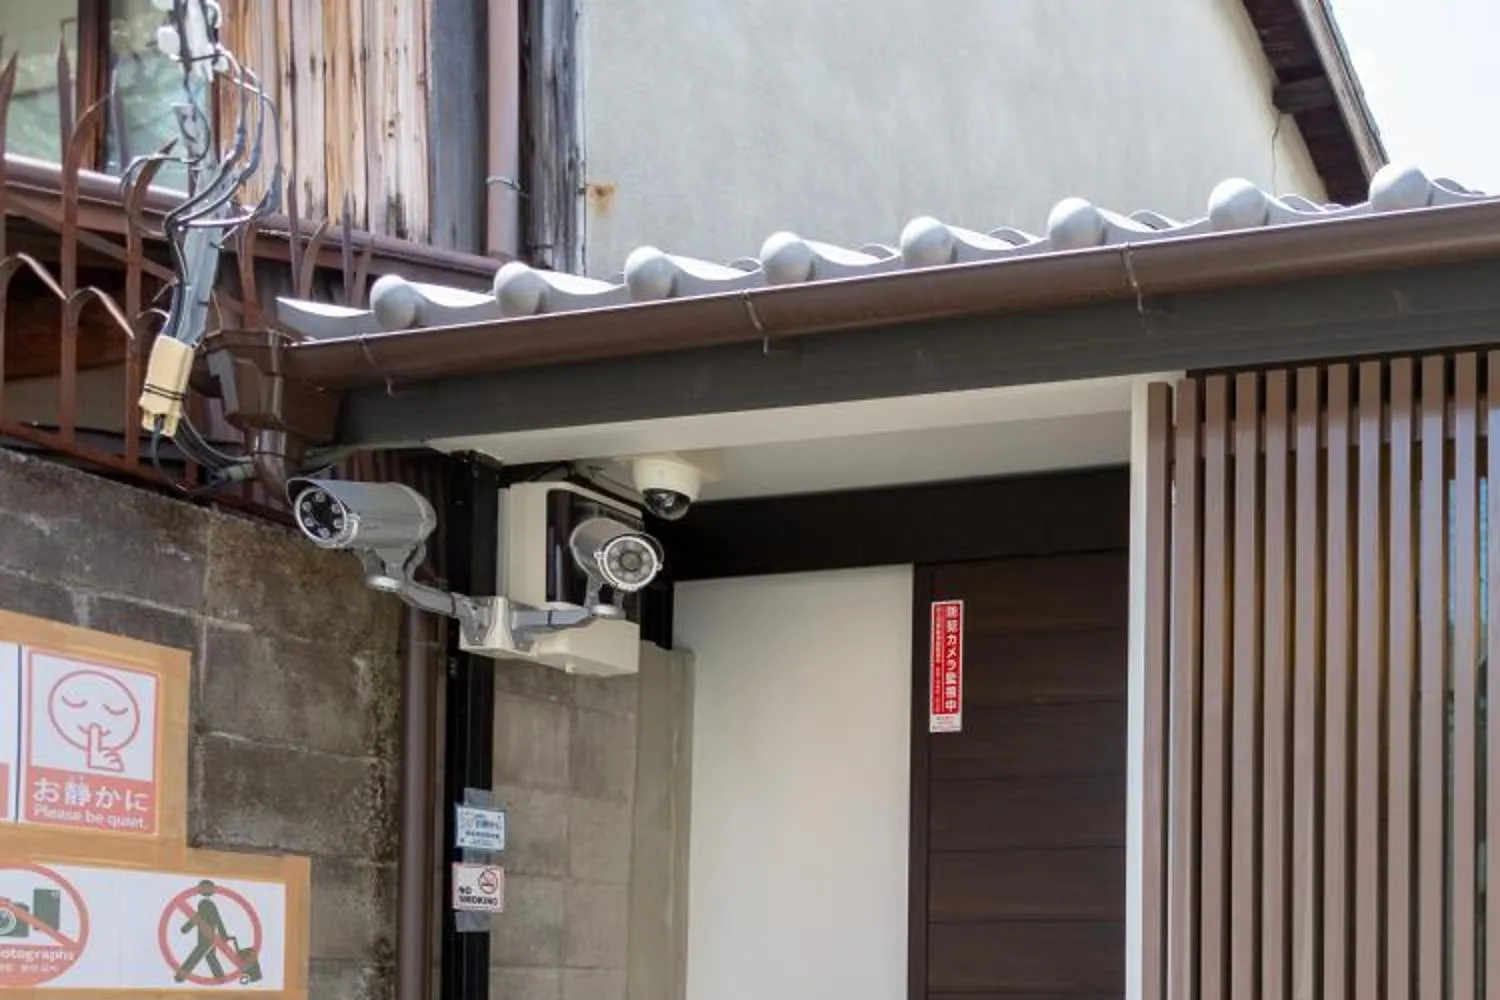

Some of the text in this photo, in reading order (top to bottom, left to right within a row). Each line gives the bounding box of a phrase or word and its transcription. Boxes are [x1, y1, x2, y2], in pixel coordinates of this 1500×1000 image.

[33, 776, 149, 812] お静かに
[33, 803, 82, 821] Please
[85, 810, 104, 824] be
